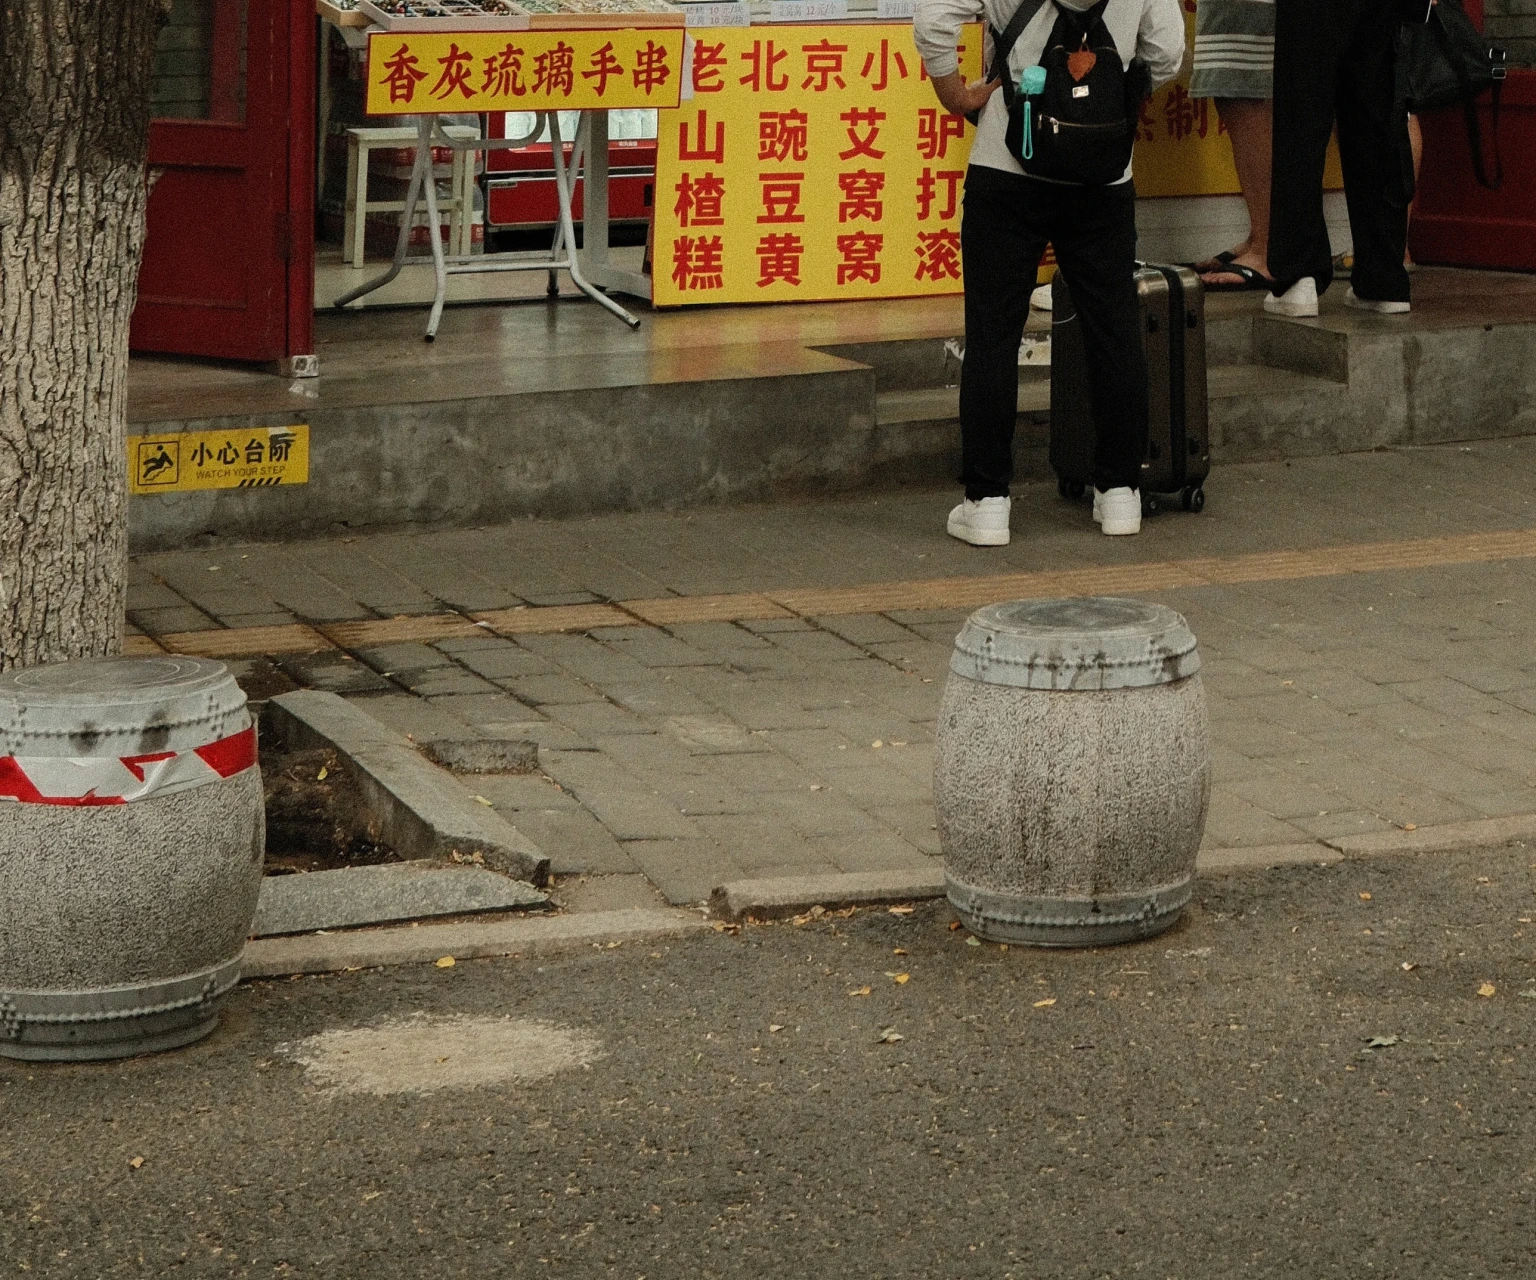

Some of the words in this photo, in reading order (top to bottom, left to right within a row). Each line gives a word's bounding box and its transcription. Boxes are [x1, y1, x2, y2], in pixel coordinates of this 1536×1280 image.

[379, 40, 670, 104] 香灰琉璃手串
[673, 110, 726, 291] 山楂糕
[755, 108, 808, 288] 豌豆黄
[836, 107, 888, 285] 艾窝窝
[914, 108, 965, 281] 驴打滚
[190, 434, 294, 467] 小心台阶
[196, 470, 231, 480] WATCH
[233, 467, 258, 477] YOUR
[259, 465, 286, 475] STEP
